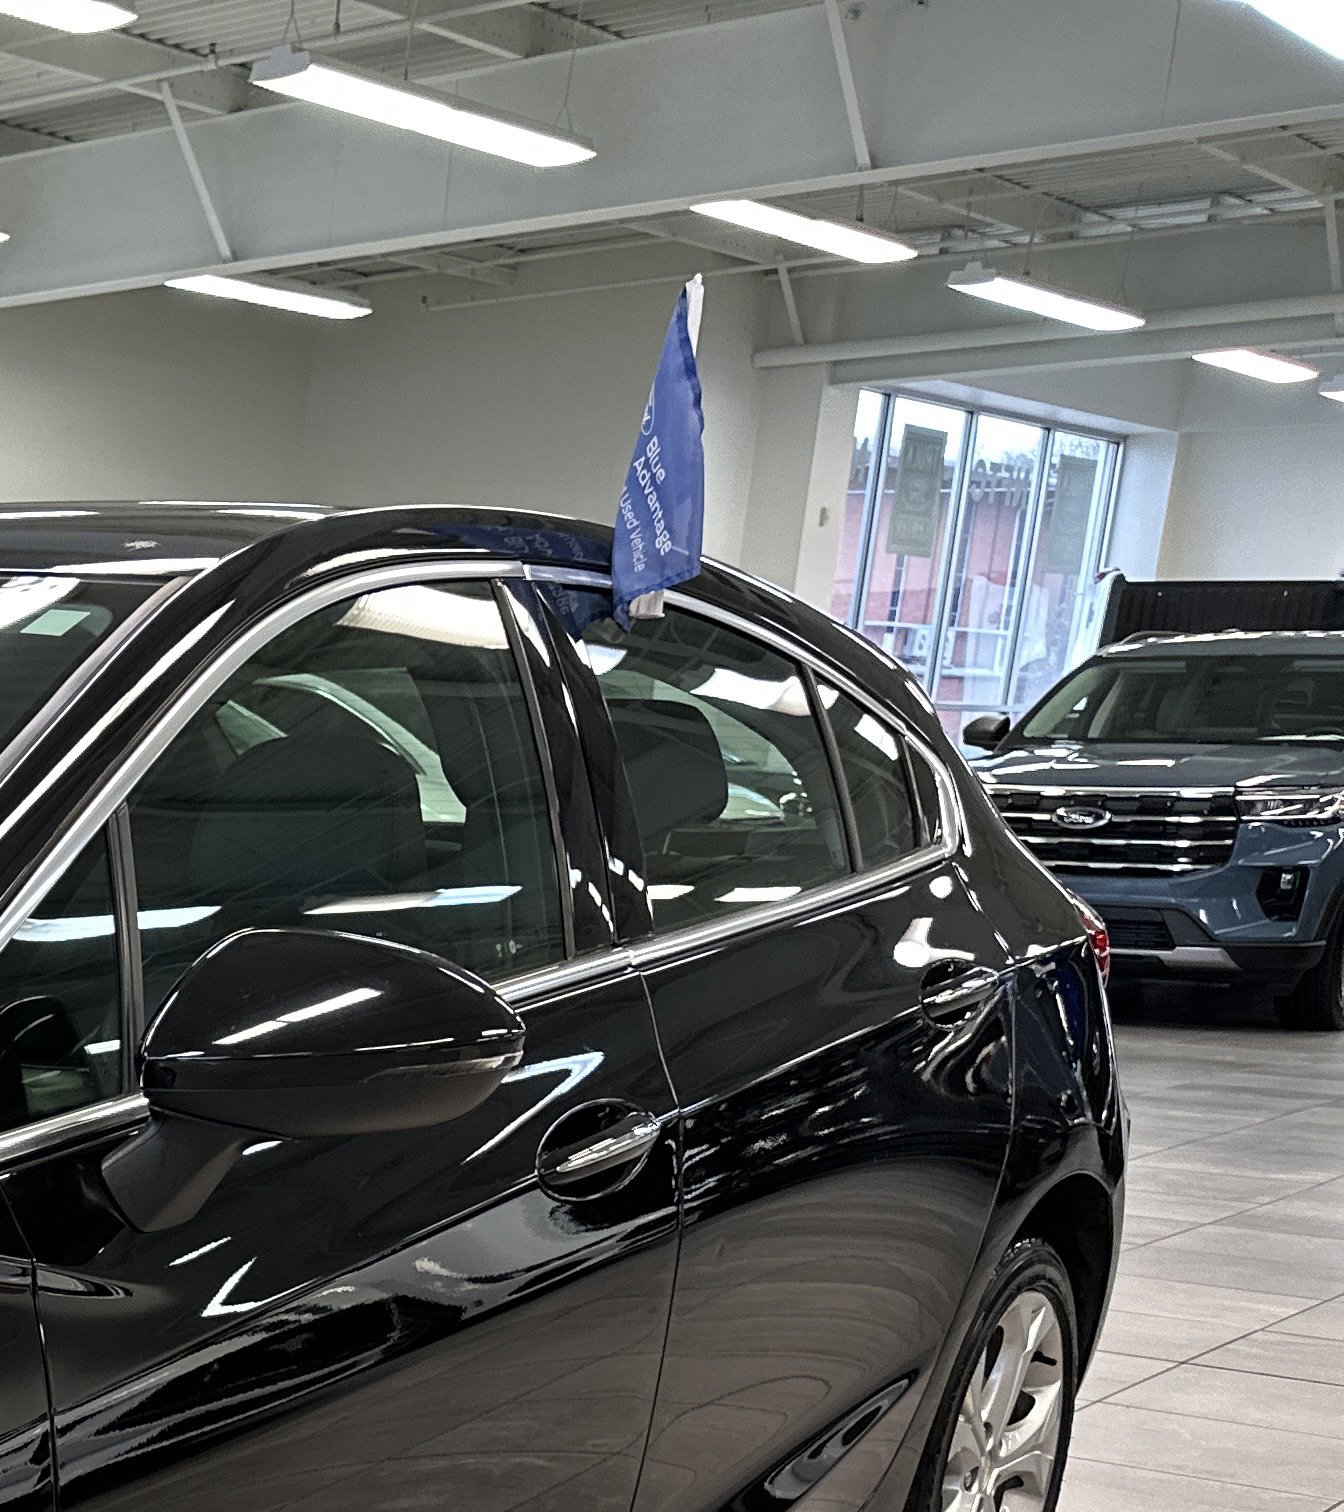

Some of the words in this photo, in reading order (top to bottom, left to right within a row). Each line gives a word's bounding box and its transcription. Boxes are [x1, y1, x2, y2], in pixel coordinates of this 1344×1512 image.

[645, 435, 666, 485] Blue
[619, 496, 641, 530] Used
[631, 526, 646, 573] Vehicle
[632, 455, 672, 556] Advantage
